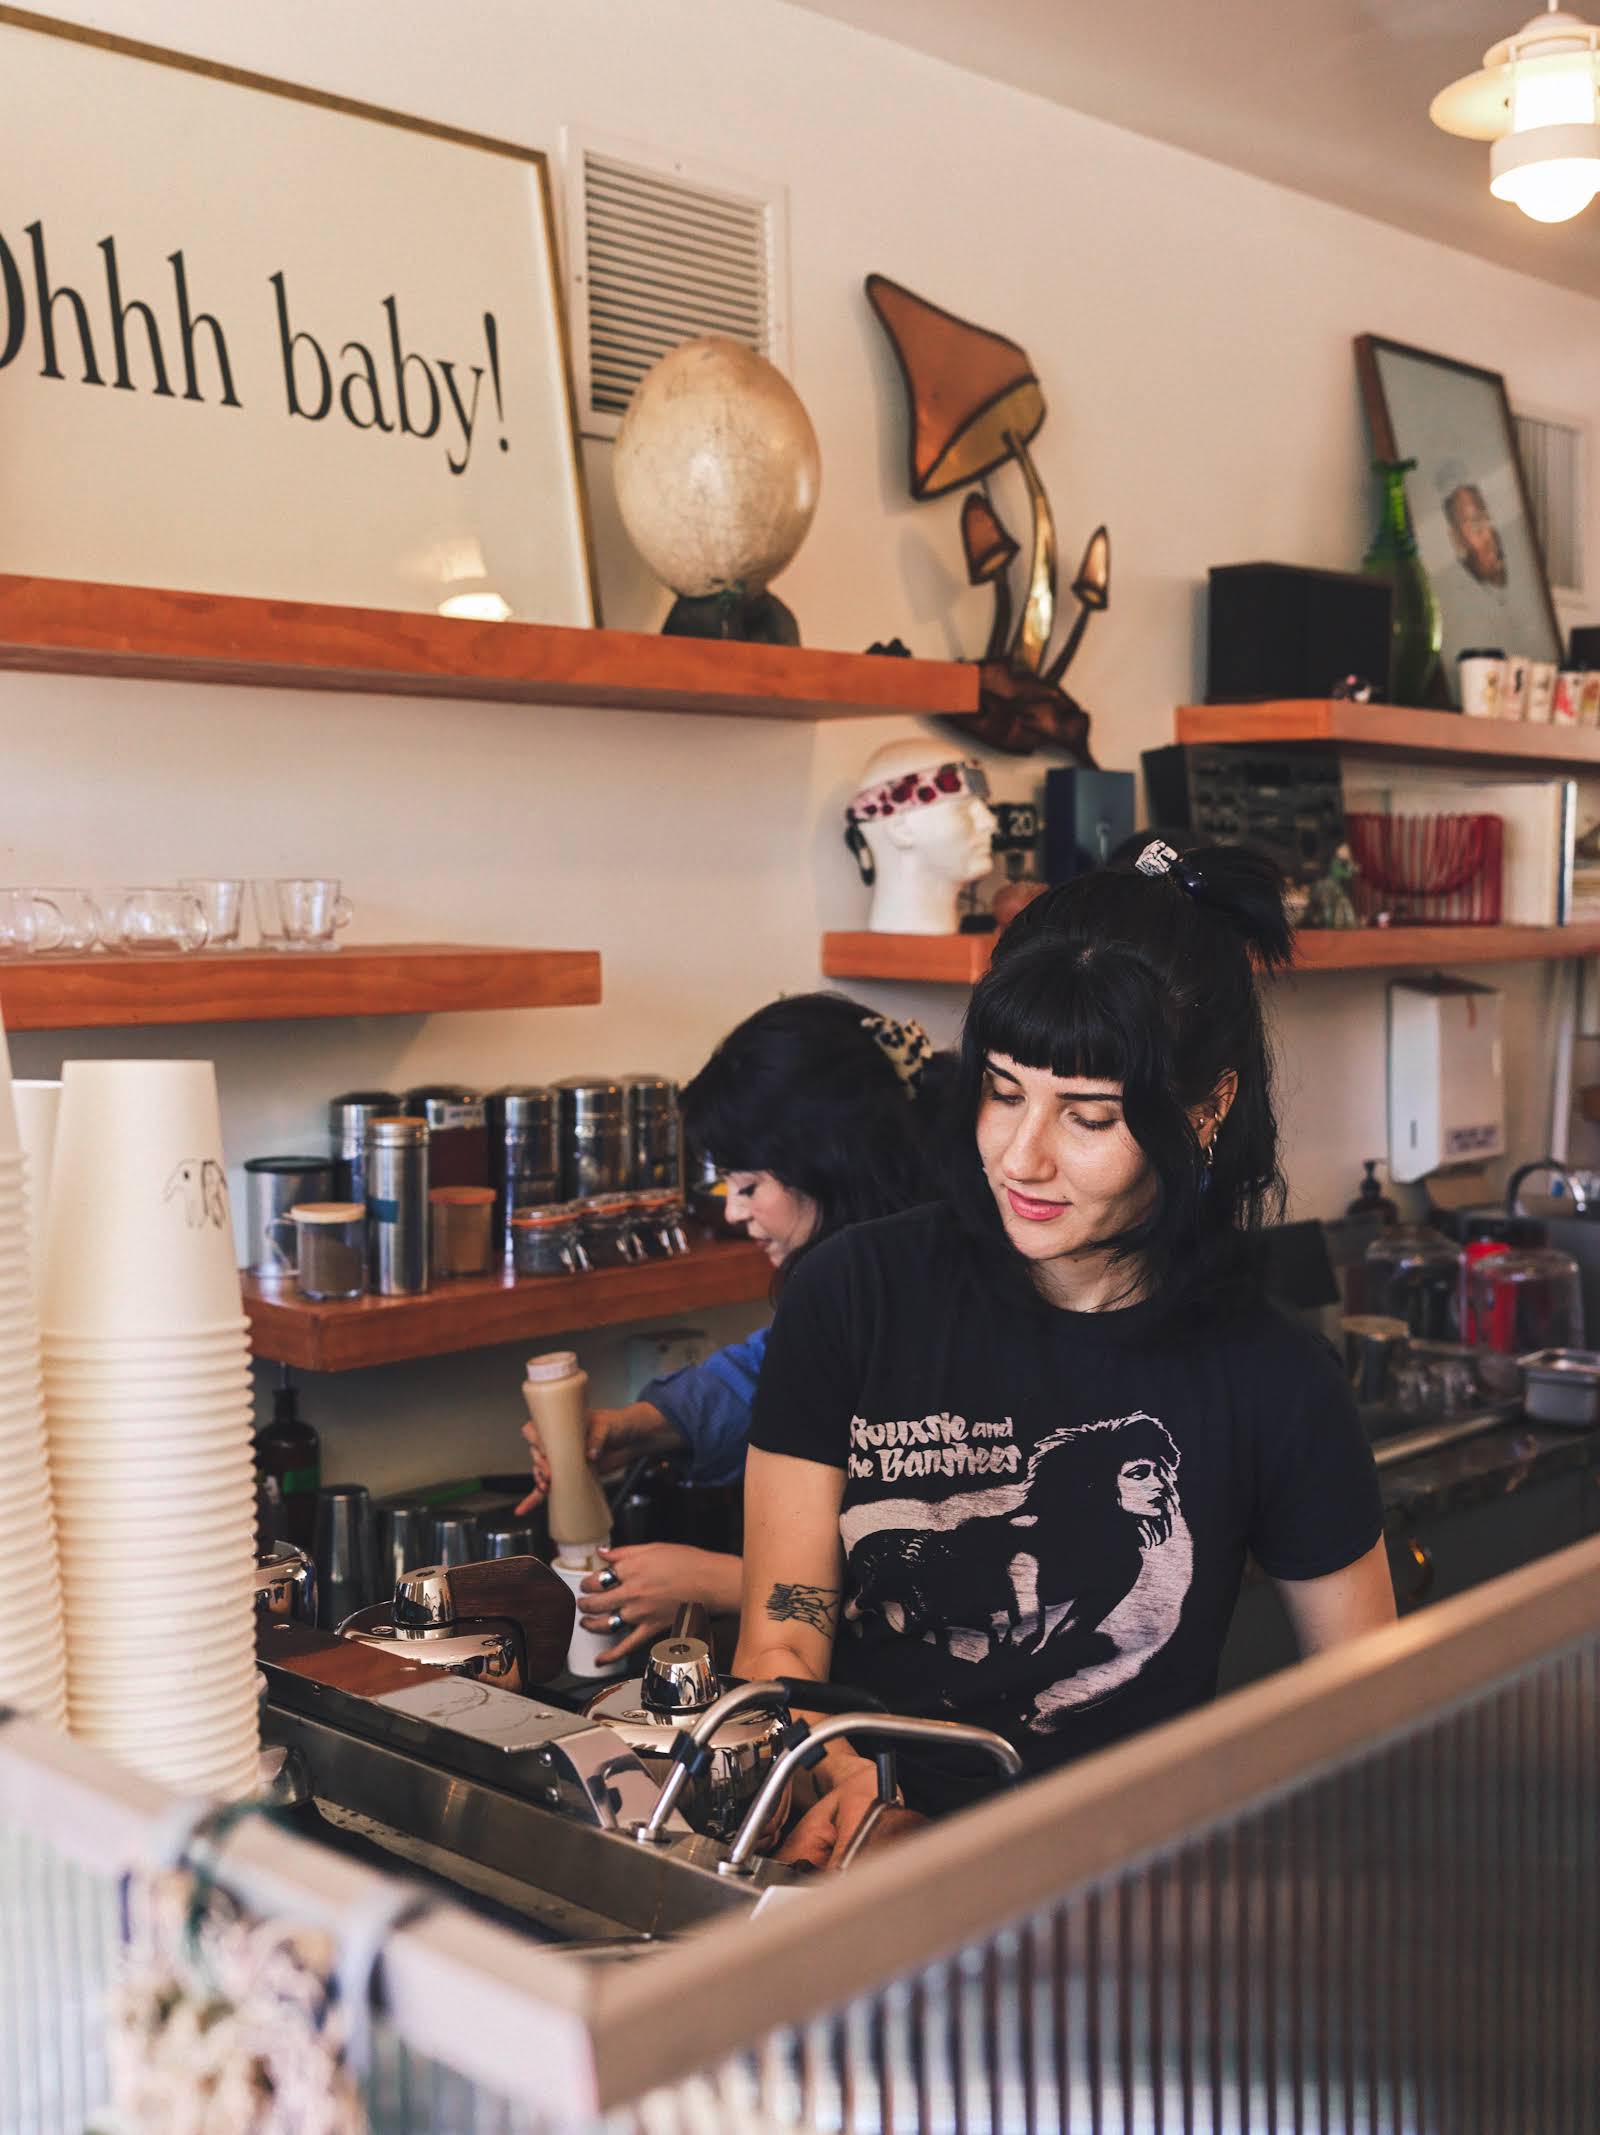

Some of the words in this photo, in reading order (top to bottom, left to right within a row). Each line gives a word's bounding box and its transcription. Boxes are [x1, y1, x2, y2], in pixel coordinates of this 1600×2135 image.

[269, 270, 509, 475] baby!
[971, 1416, 1014, 1439] and
[875, 1441, 1023, 1483] Banshees
